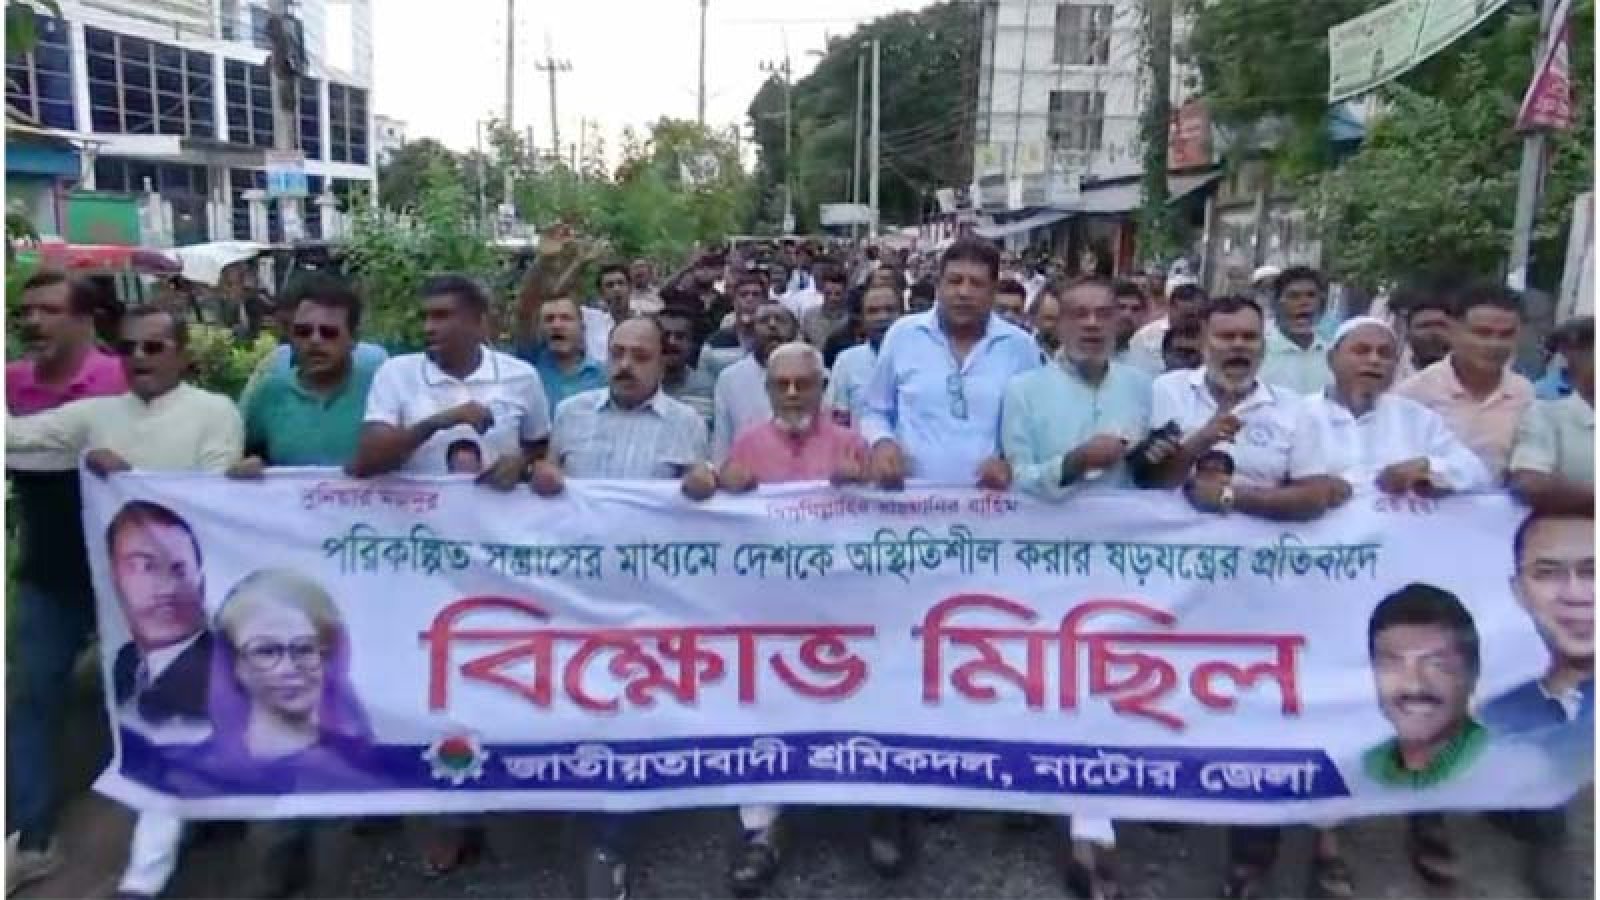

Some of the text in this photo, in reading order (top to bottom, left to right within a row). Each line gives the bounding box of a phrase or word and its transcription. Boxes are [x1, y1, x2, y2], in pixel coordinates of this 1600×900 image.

[322, 523, 473, 576] পরিকল্পিত
[615, 540, 721, 580] মাধ্যমে
[733, 541, 834, 580] দেশকে
[846, 524, 1002, 584] অস্থিতিশীল
[1012, 538, 1092, 577] করার
[1252, 531, 1381, 583] প্রতিবাদে
[419, 593, 1306, 732] বিক্ষোভ মিছিল
[501, 736, 1321, 794] জাতীয়তাবাদী শ্রমিকদল, নাটোর জেলা
